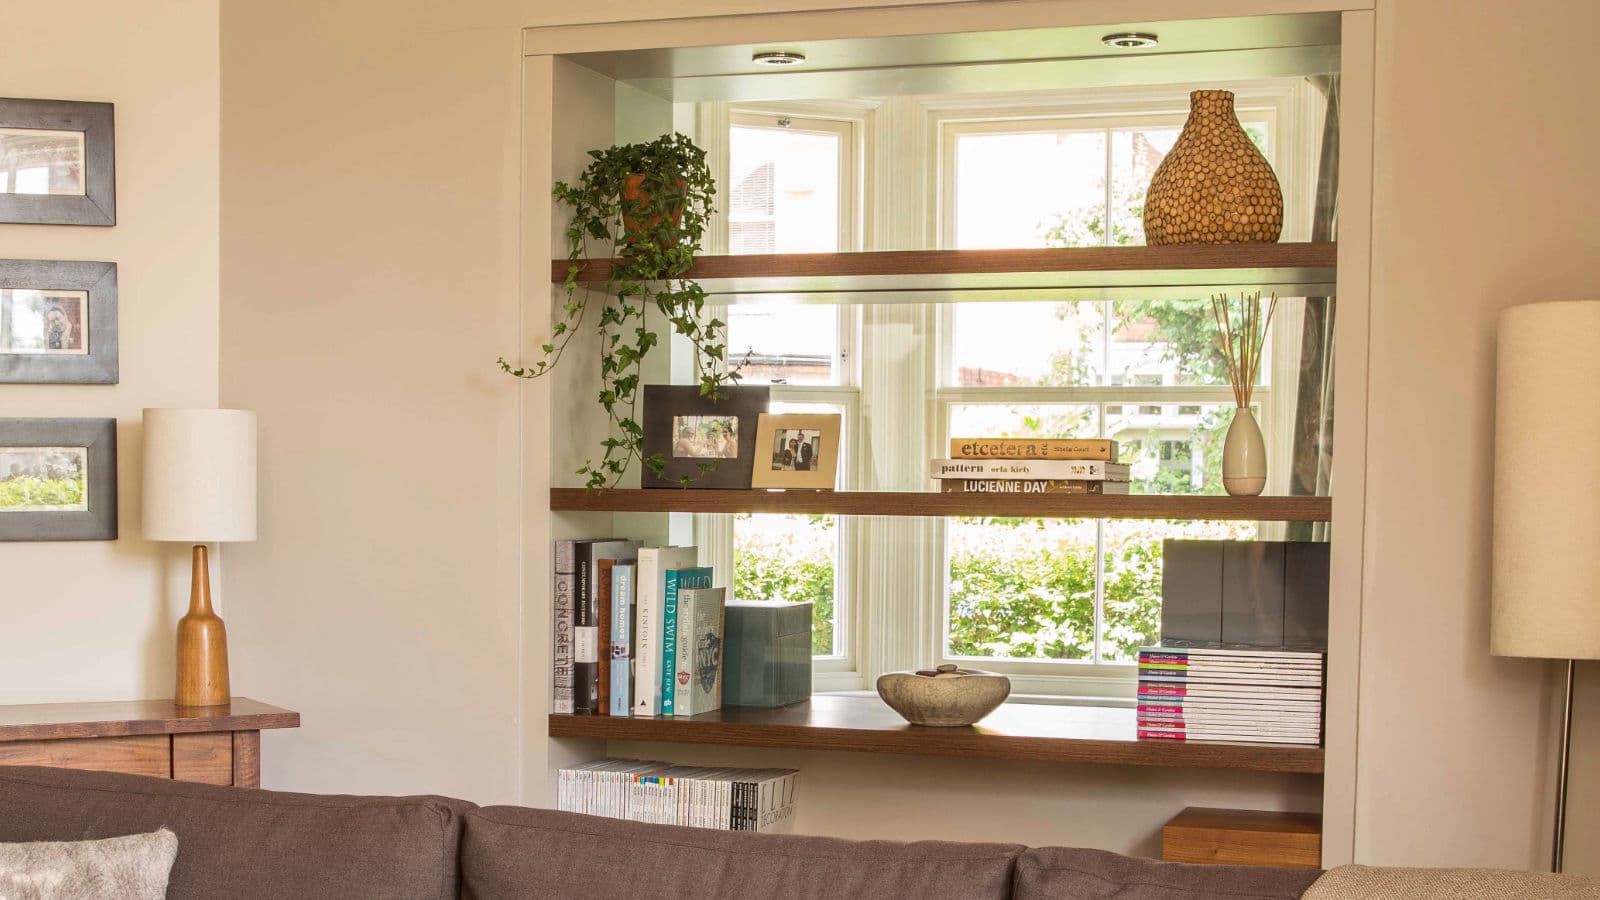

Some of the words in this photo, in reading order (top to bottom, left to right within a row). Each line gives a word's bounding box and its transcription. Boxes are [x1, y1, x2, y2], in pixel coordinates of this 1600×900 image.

[961, 441, 1037, 456] etcetera
[941, 464, 983, 475] pattern
[963, 480, 1021, 493] LUCIENNE
[1023, 481, 1048, 494] DAY
[619, 575, 627, 605] dream
[665, 578, 677, 614] WILD
[683, 594, 691, 605] the
[557, 581, 569, 676] CONCRETE
[641, 608, 649, 649] KINFOLK
[664, 618, 676, 653] SWIM
